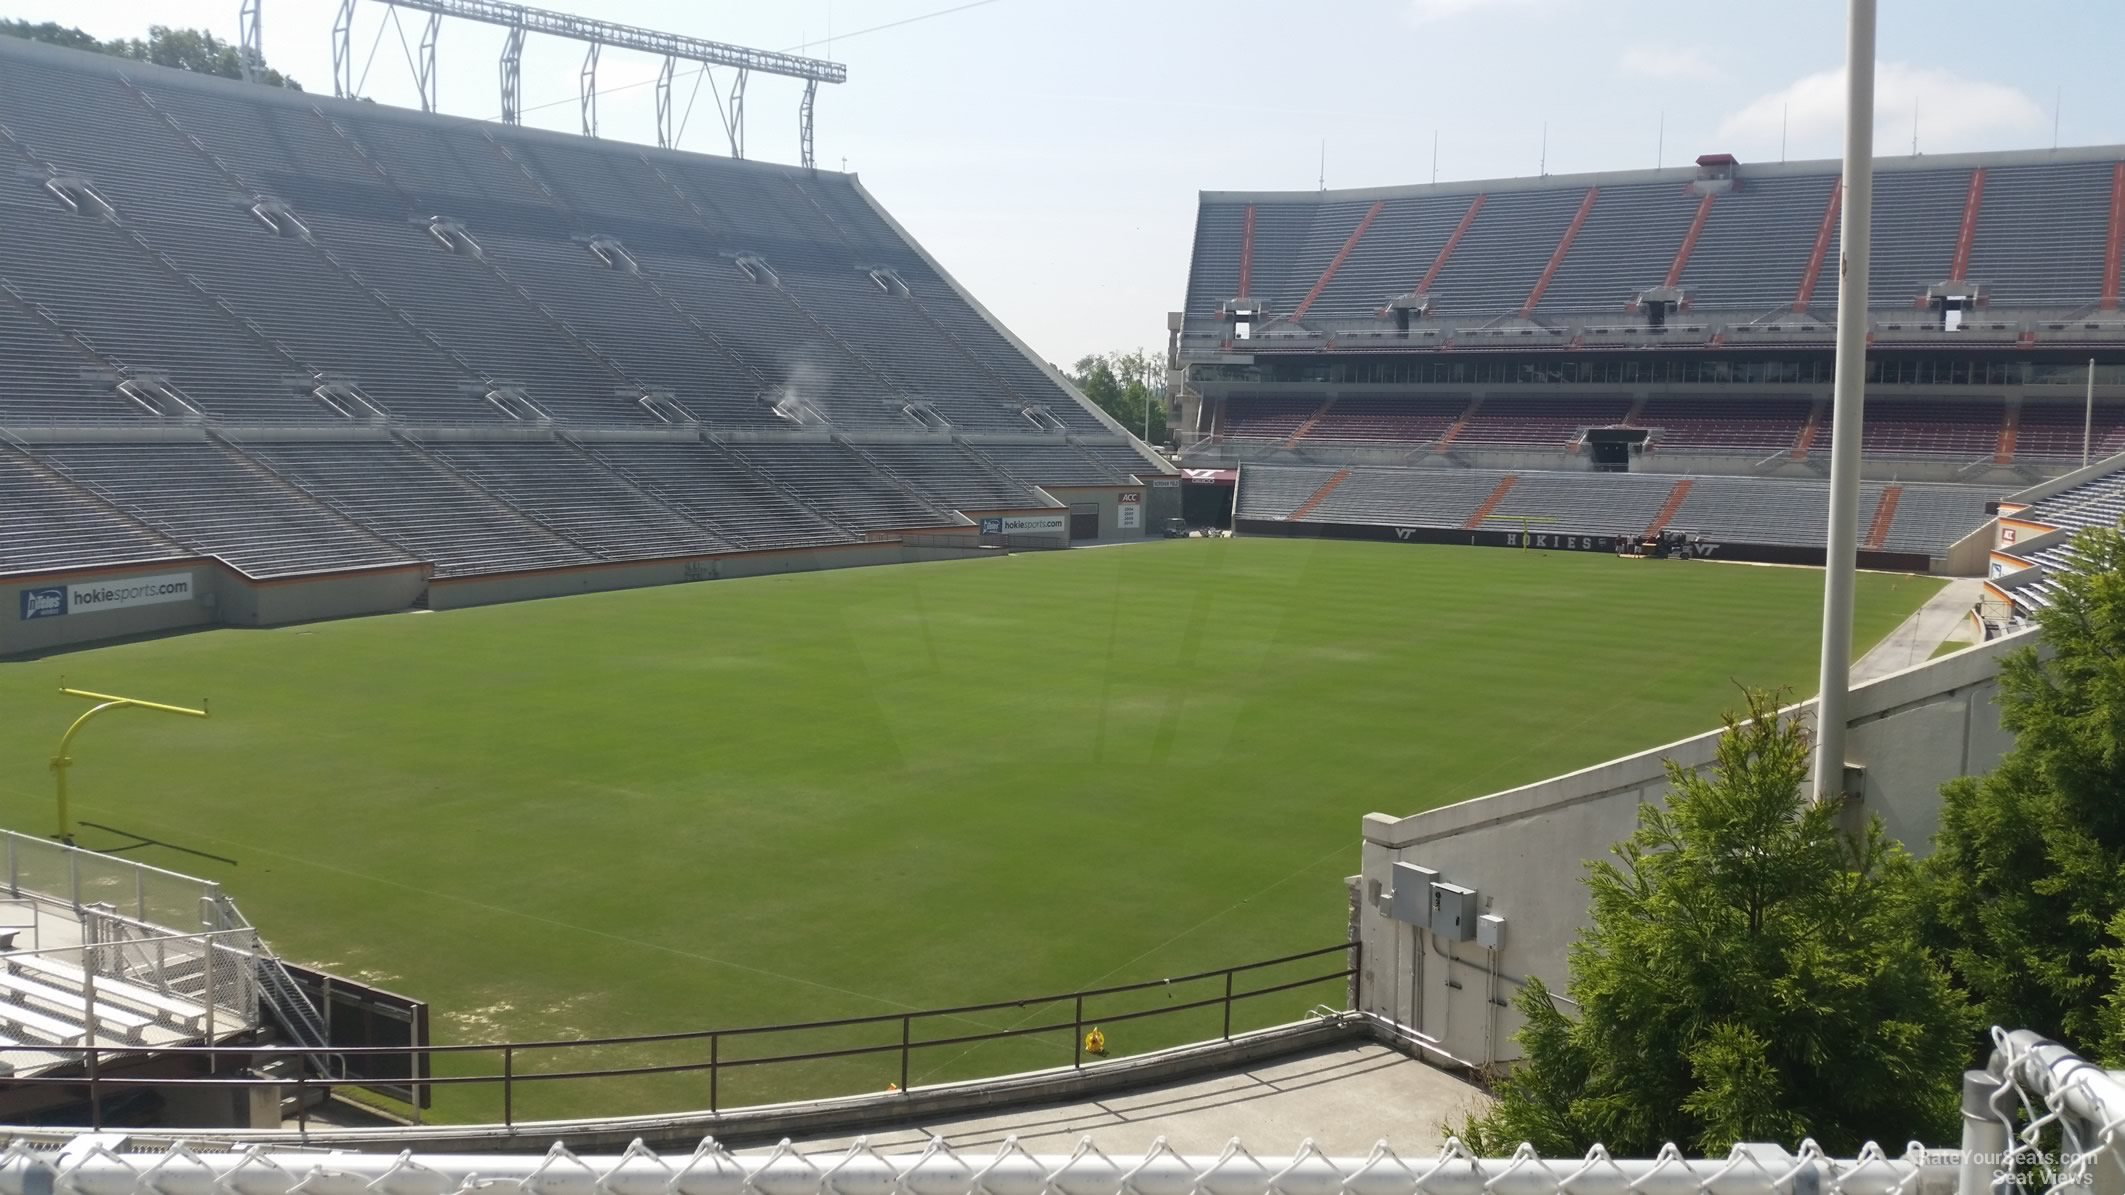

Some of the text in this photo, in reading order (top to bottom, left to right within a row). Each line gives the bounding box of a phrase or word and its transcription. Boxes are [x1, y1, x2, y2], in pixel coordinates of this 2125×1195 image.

[1005, 520, 1062, 530] hokiesports.com
[1395, 528, 1416, 539] VT
[1507, 534, 1592, 549] HOKIES
[1694, 544, 1721, 556] VT
[74, 580, 188, 606] hokiesports.com
